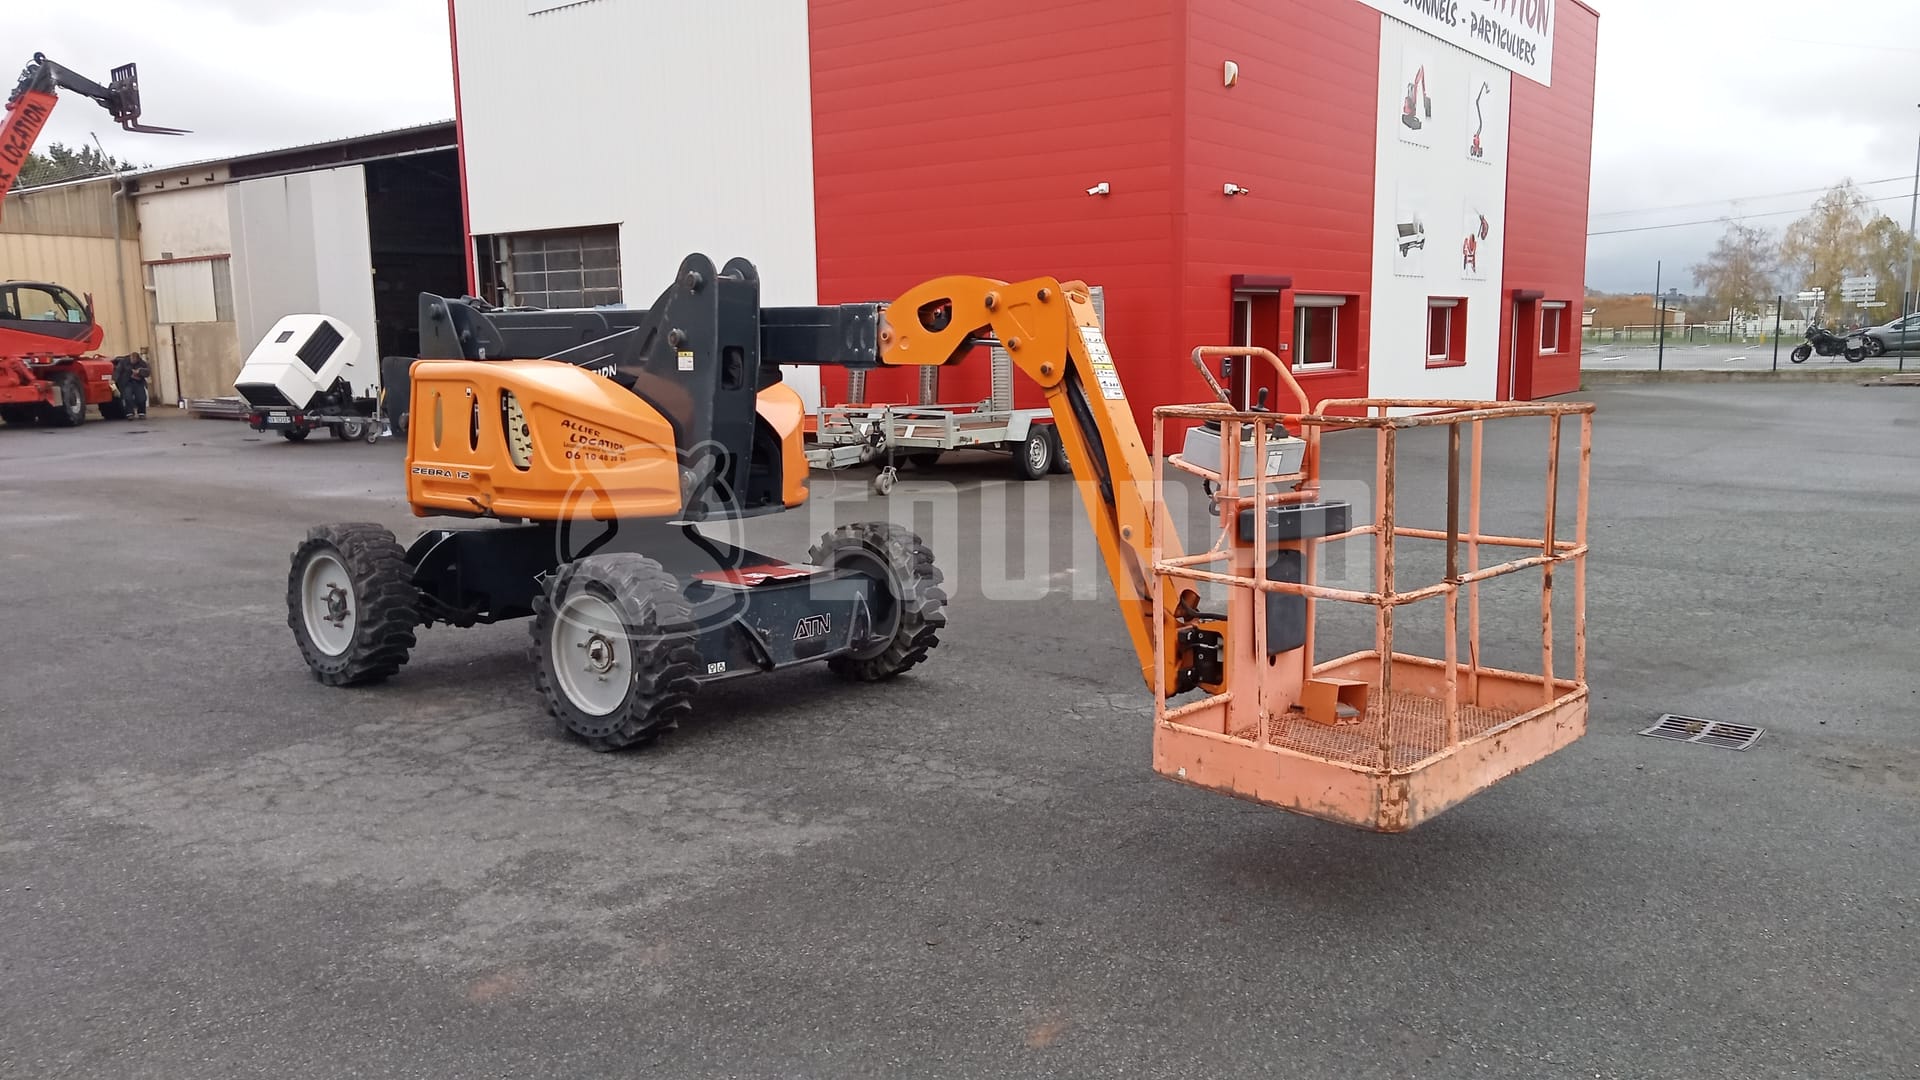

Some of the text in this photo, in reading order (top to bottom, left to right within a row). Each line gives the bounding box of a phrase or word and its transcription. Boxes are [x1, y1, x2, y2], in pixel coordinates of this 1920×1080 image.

[1470, 10, 1537, 66] PARTICULIERS
[0, 103, 48, 166] LOCATION
[560, 419, 601, 438] ALLIER
[569, 433, 625, 451] LOCATION
[565, 450, 581, 460] 06
[585, 452, 597, 461] 10
[412, 467, 471, 480] ZEBRA 12
[792, 612, 831, 641] ATN
